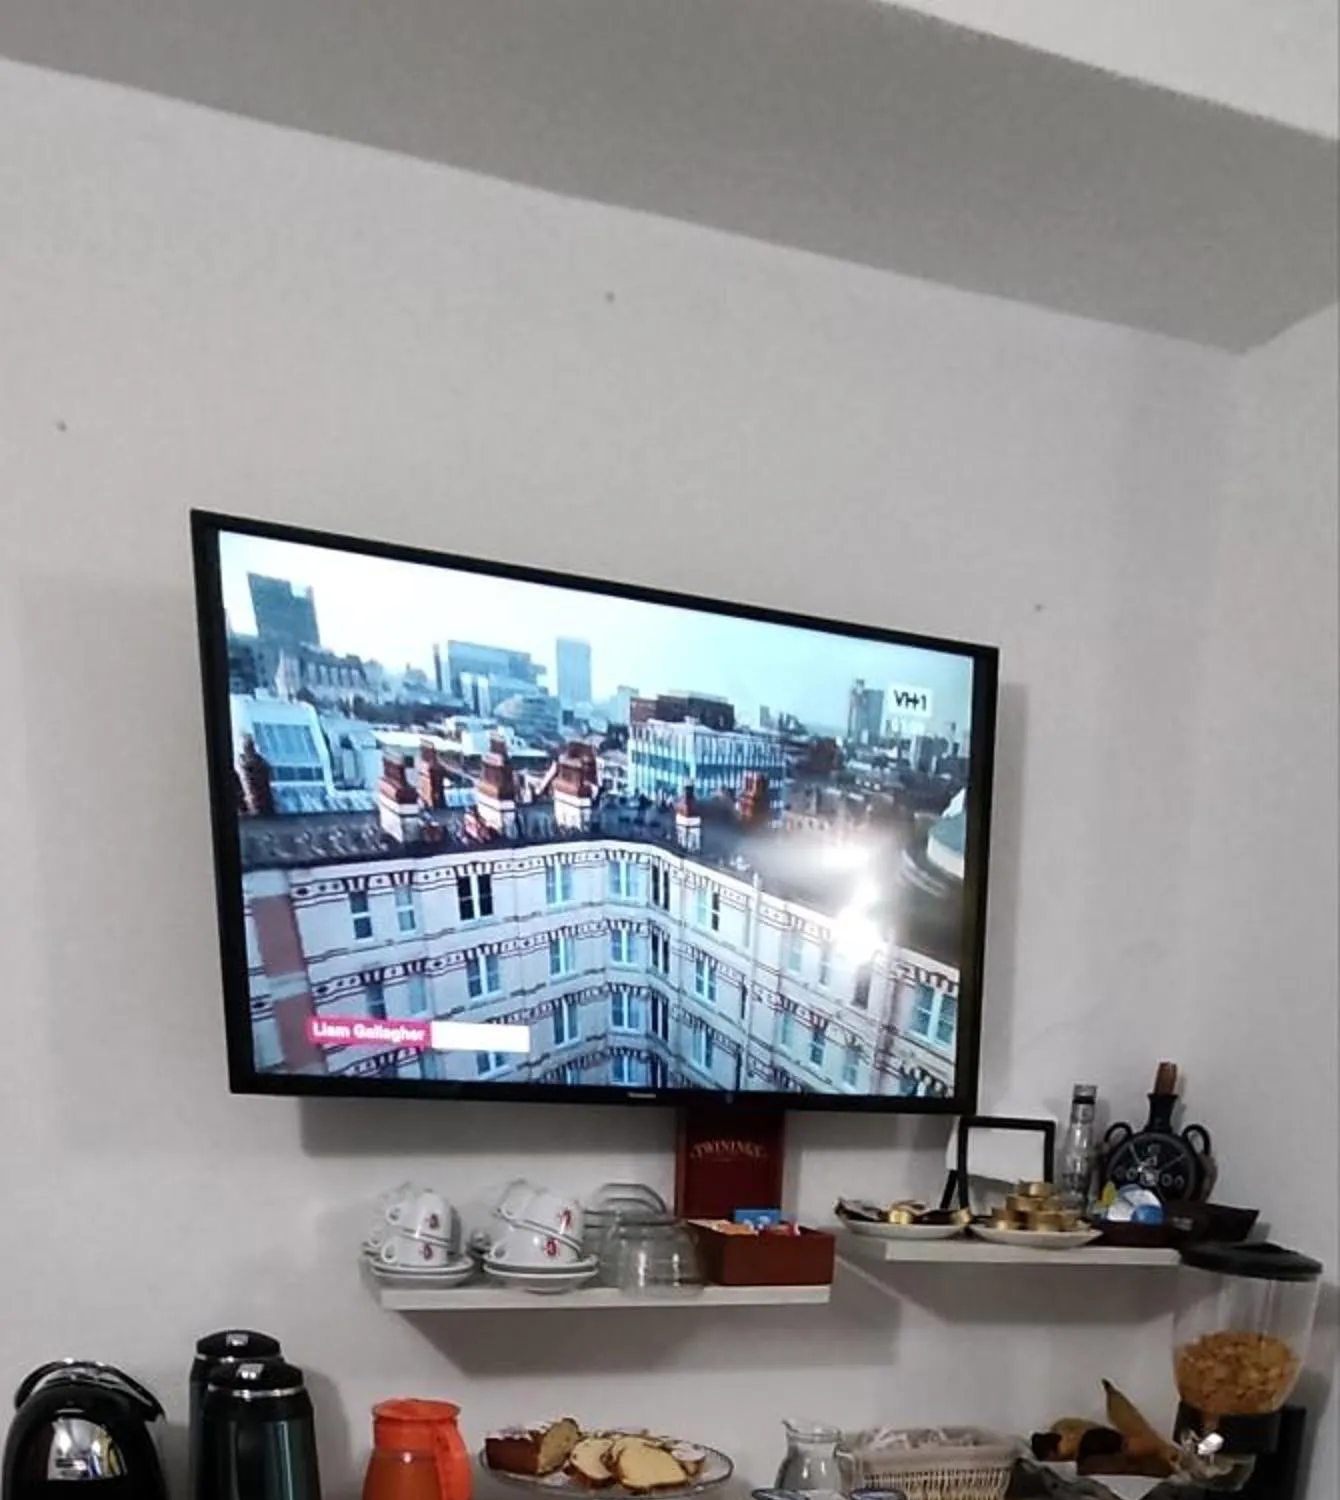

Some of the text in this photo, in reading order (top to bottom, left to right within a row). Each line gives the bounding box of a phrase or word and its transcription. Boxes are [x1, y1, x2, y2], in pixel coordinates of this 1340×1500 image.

[893, 689, 927, 712] VH1
[312, 1021, 426, 1043] Liam Gallagher
